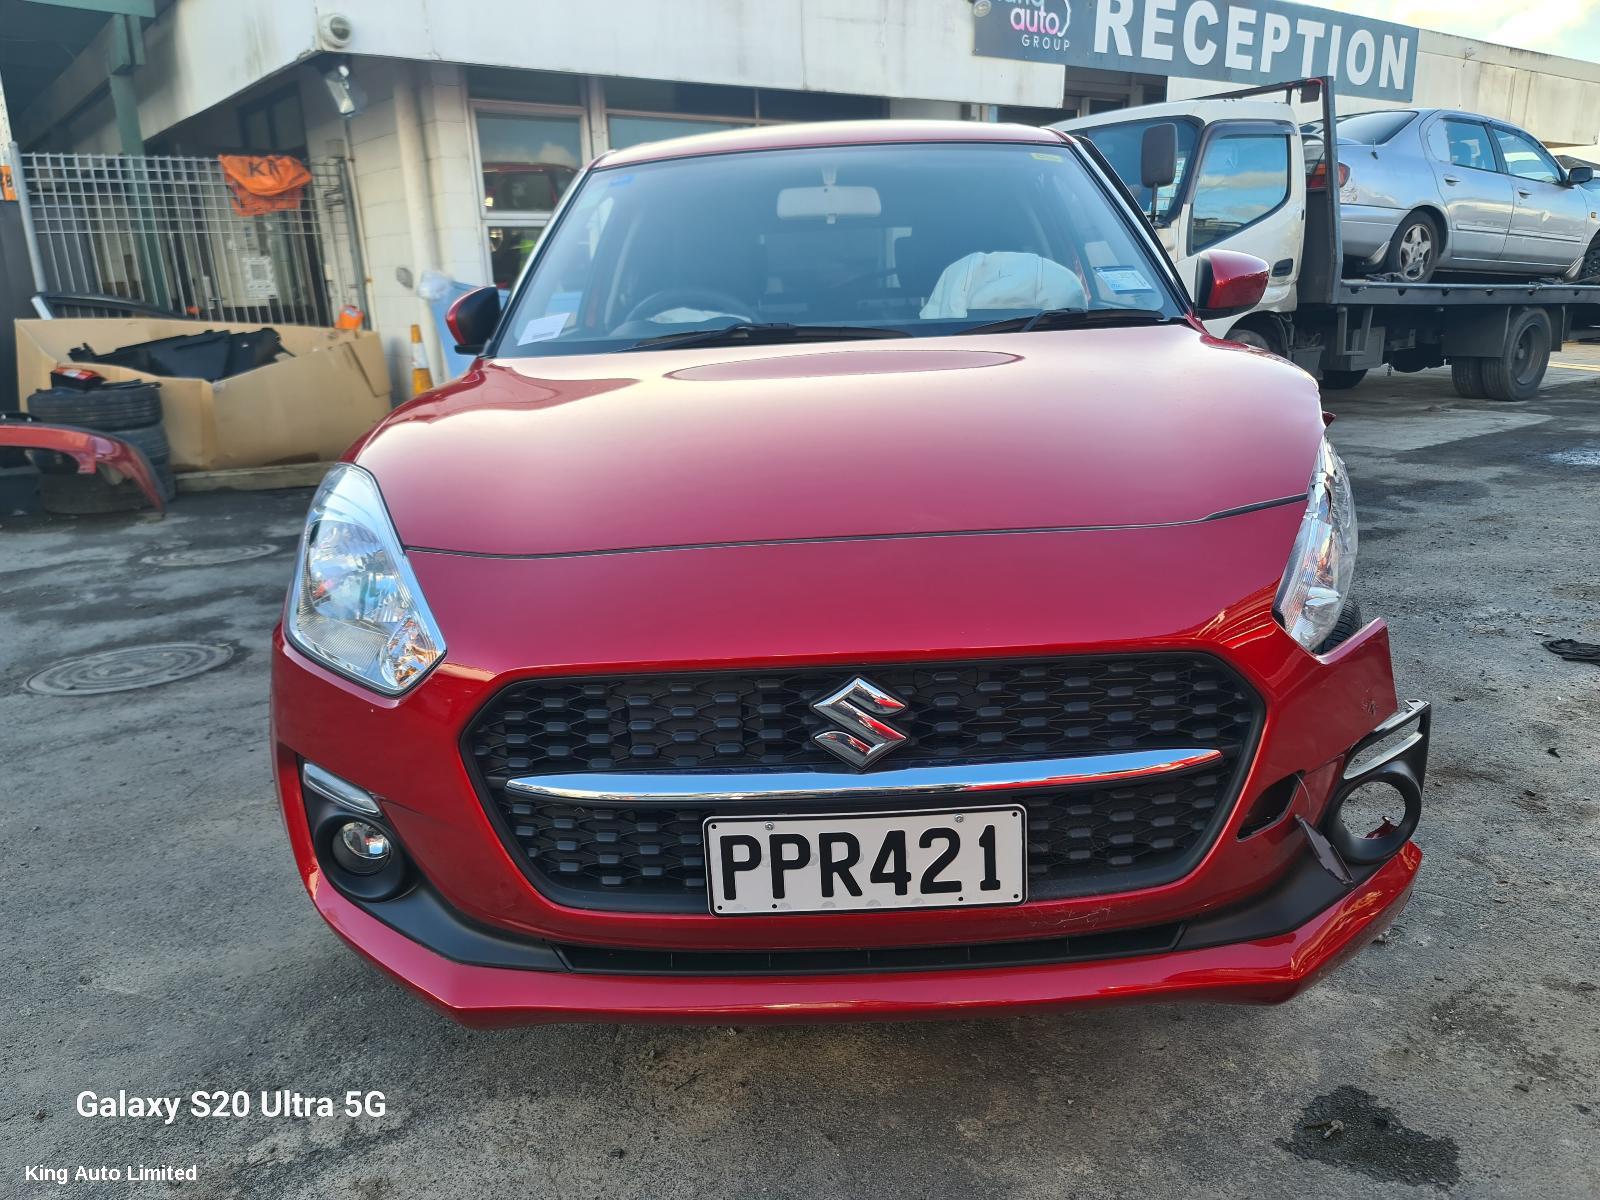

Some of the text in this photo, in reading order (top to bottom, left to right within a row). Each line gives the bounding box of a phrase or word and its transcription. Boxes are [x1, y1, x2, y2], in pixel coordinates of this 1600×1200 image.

[1010, 6, 1060, 35] auto
[1021, 34, 1071, 52] GROUP
[1093, 0, 1409, 90] RECEPTION
[719, 824, 1001, 901] PPR421
